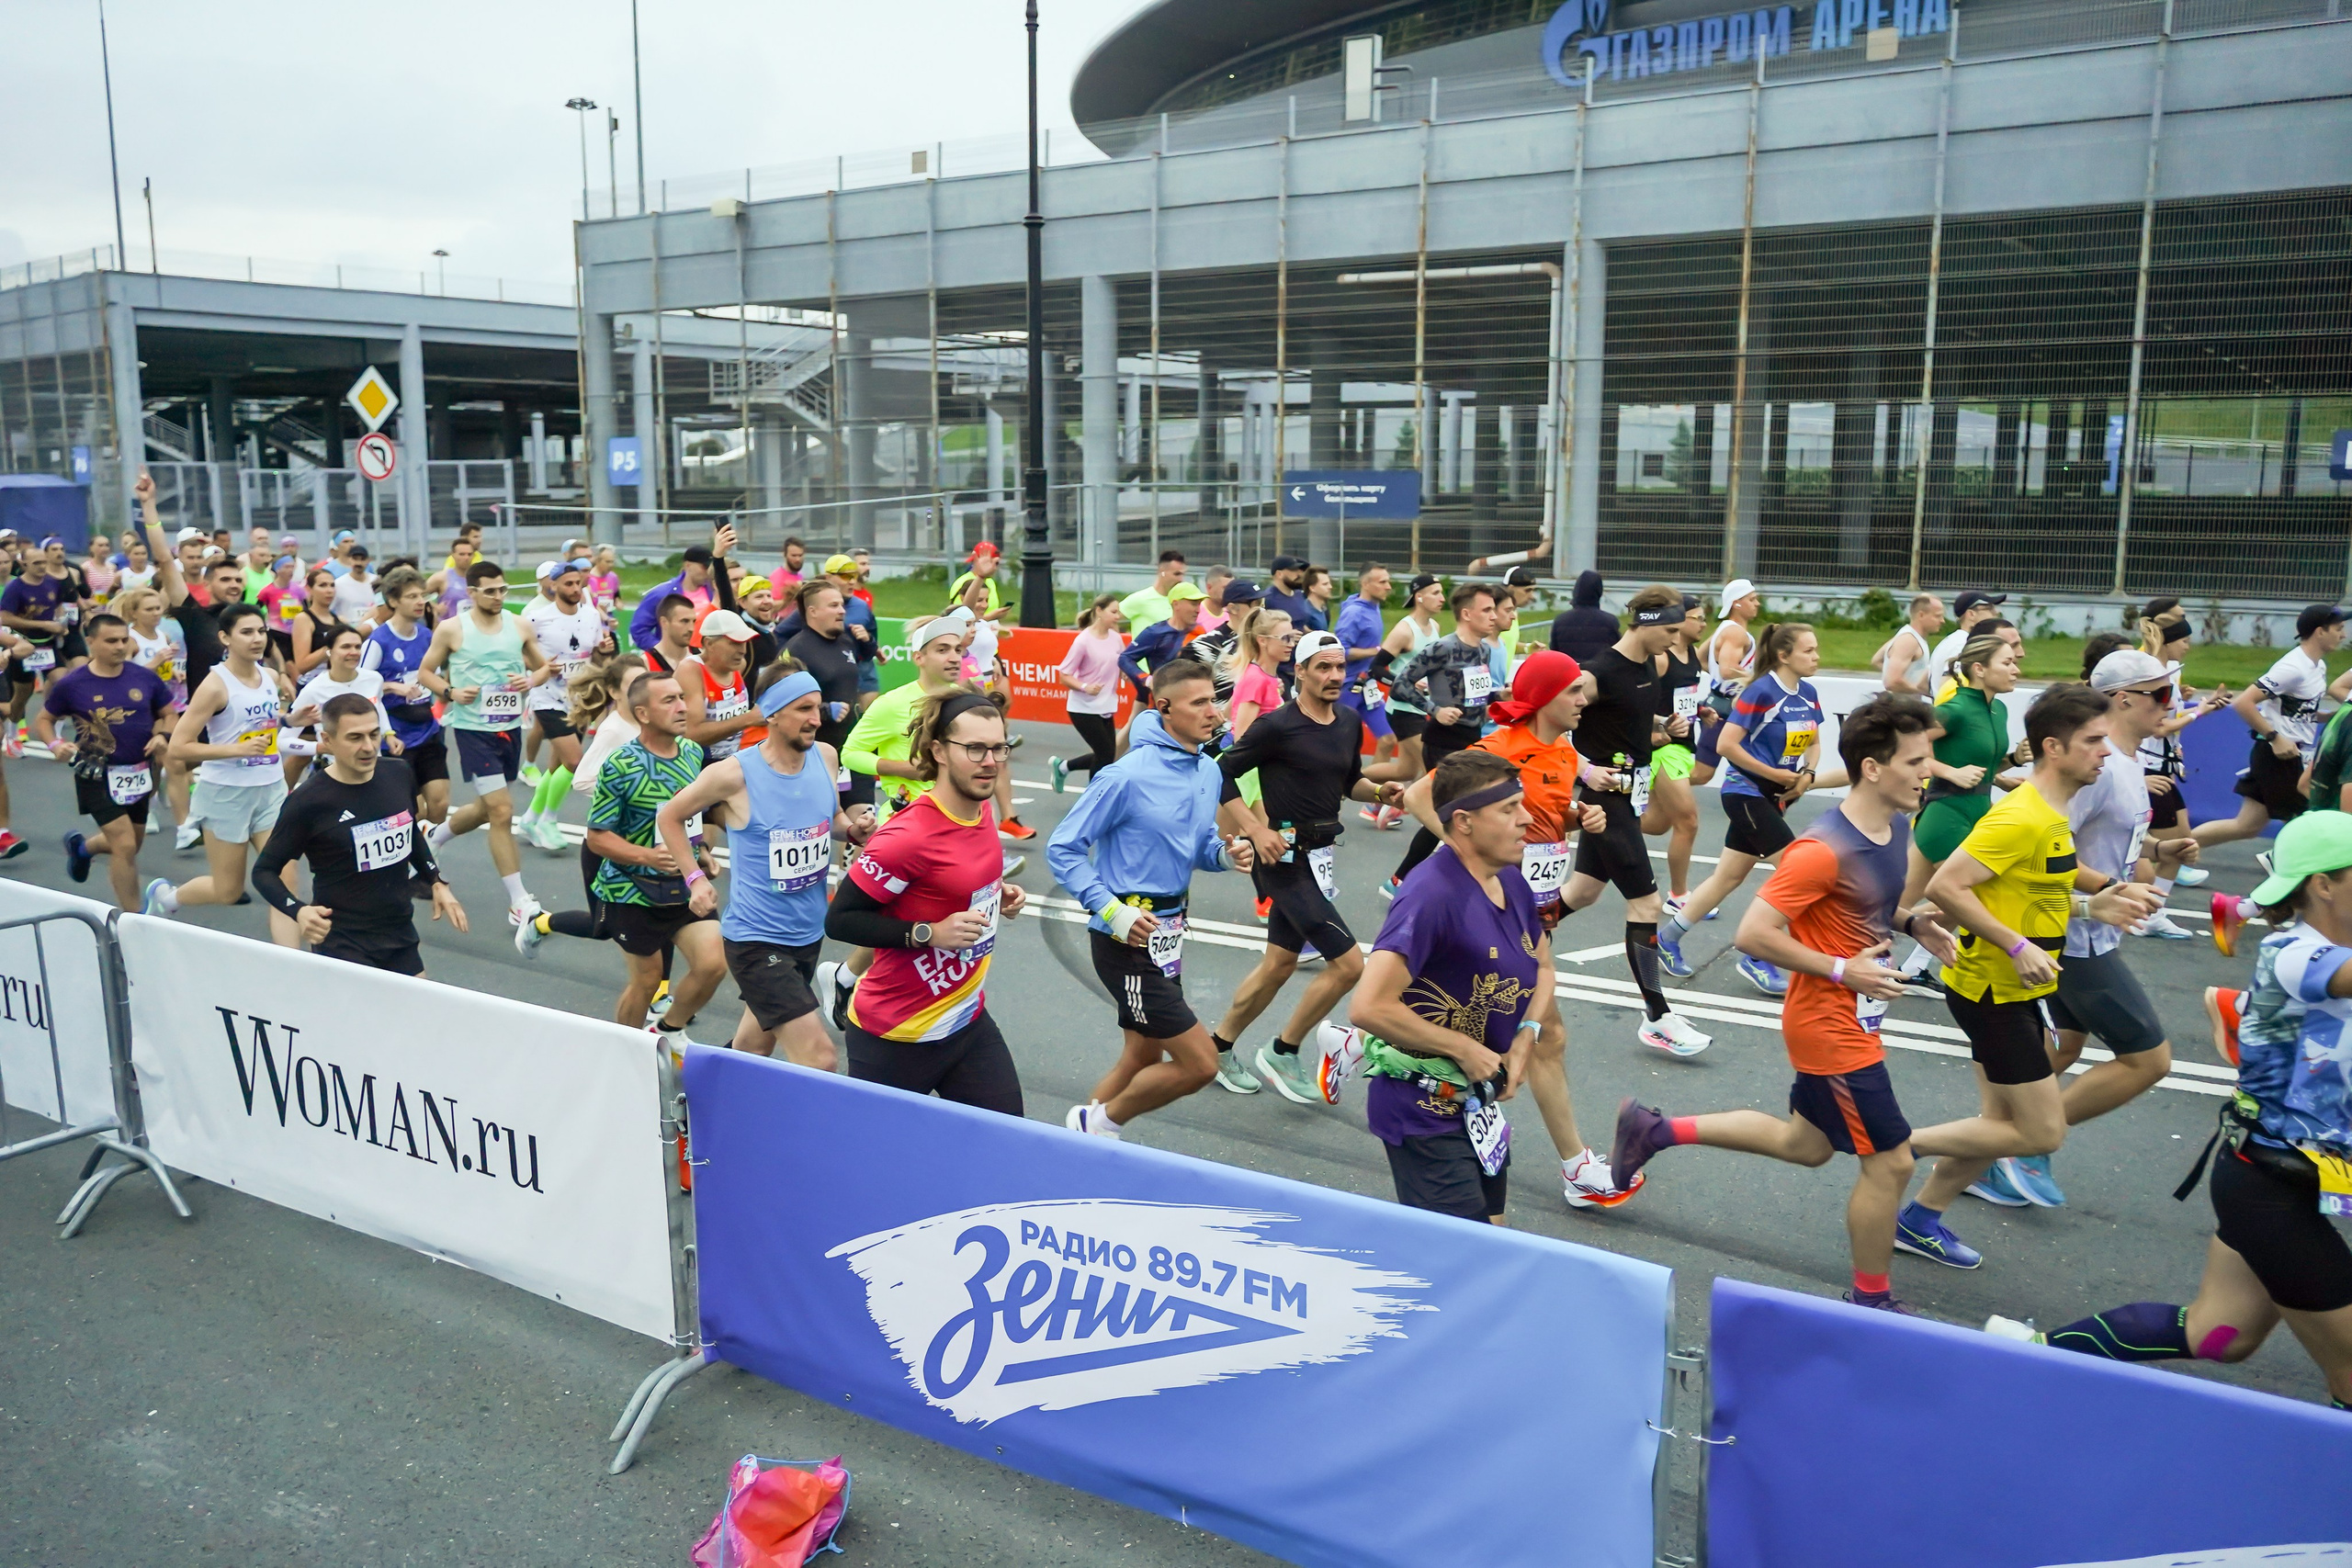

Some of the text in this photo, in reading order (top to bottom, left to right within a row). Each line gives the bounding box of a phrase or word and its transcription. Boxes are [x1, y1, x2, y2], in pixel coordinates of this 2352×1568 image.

[1611, 8, 1792, 81] ГАЗПРОМ
[613, 451, 636, 471] P5
[1470, 676, 1490, 691] 9803
[486, 695, 517, 707] 6598
[360, 827, 411, 860] 11031
[774, 838, 830, 868] 10114
[794, 863, 817, 874] СЕРГЕЙ
[1530, 858, 1566, 881] 2457
[1021, 1219, 1307, 1319] РАДИО 89.7 FM
[923, 1224, 1222, 1399] Зенит
